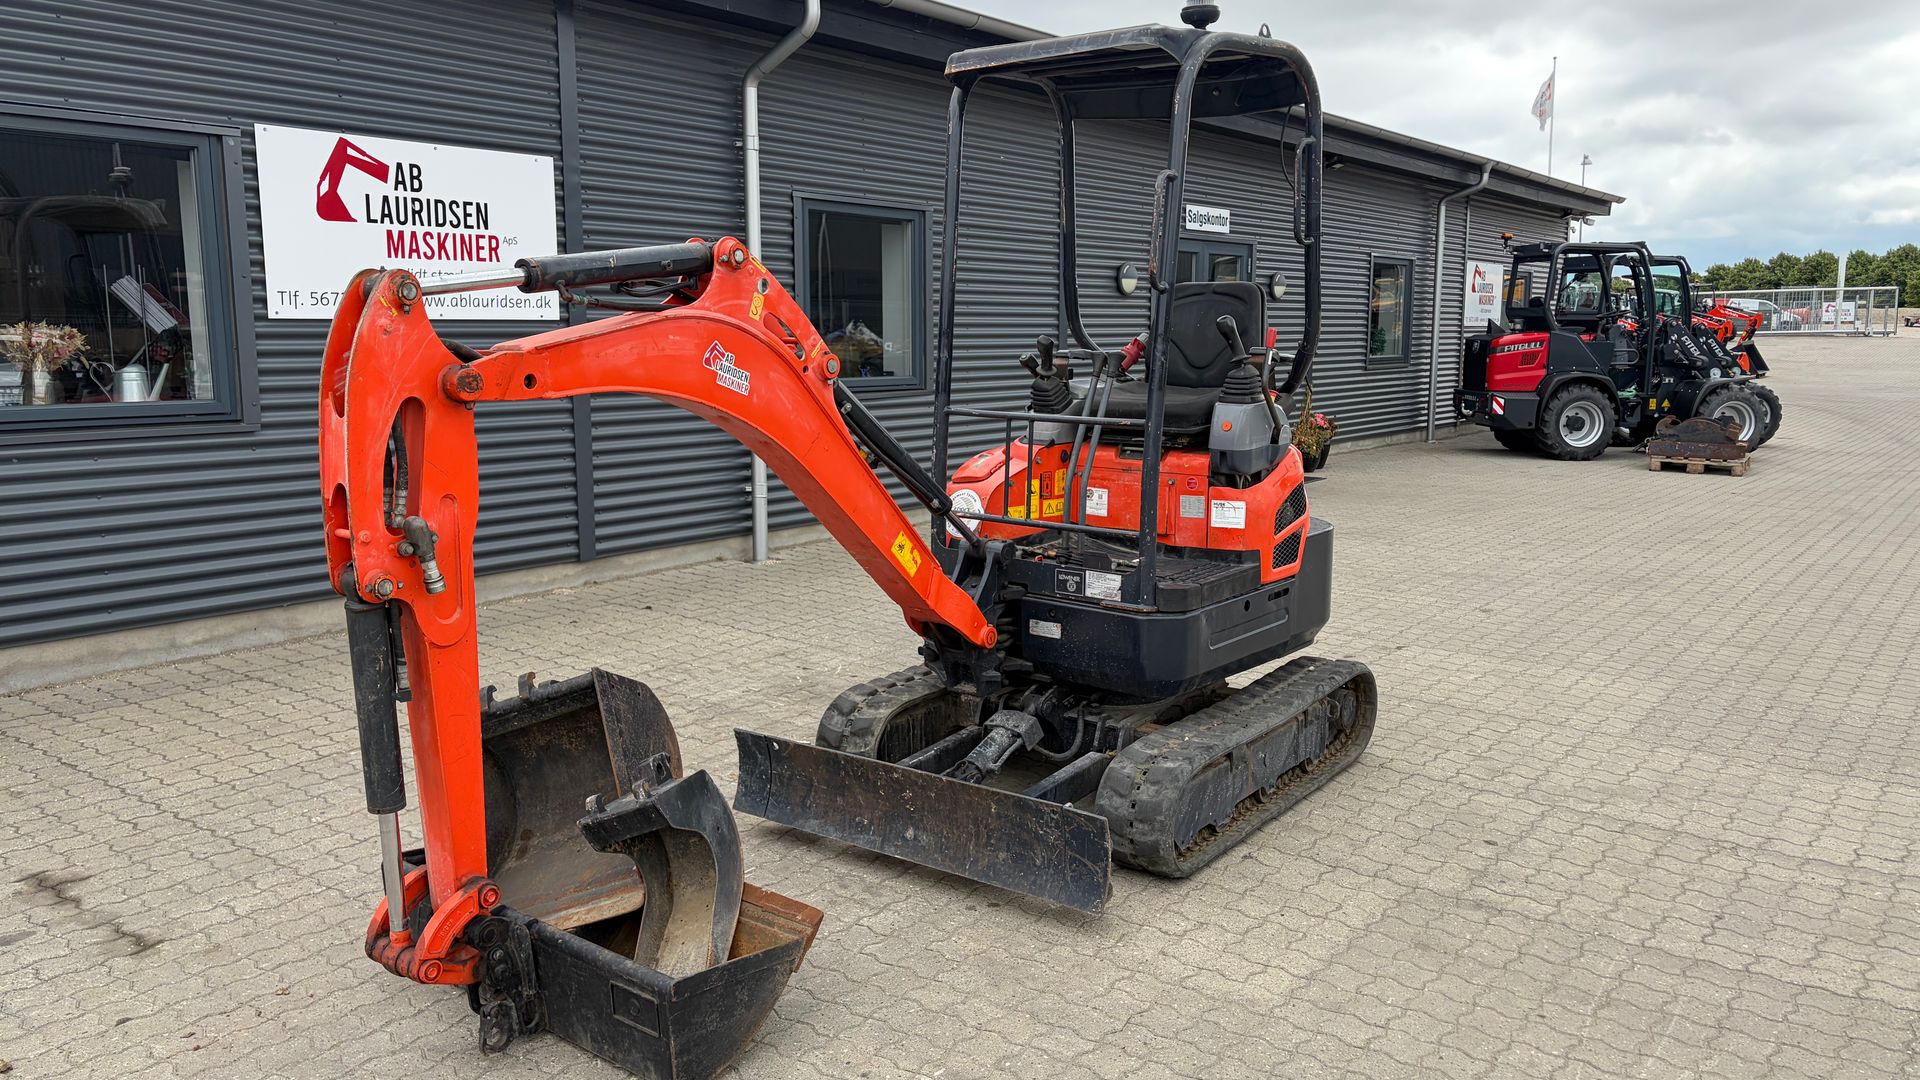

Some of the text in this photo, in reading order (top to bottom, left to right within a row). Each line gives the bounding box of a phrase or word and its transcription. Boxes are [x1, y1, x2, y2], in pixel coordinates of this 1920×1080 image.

[394, 162, 423, 193] AB
[365, 193, 490, 231] LAURIDSEN
[1188, 209, 1228, 227] Salgskontor
[386, 229, 518, 263] MASKINER ApS
[276, 290, 345, 310] Tlf. 567
[421, 285, 552, 310] ww.ablauridsen.dk
[1504, 341, 1542, 352] PITBULL
[724, 353, 734, 365] AB
[715, 360, 749, 384] LAURIDSEN
[717, 373, 749, 395] MASKINER
